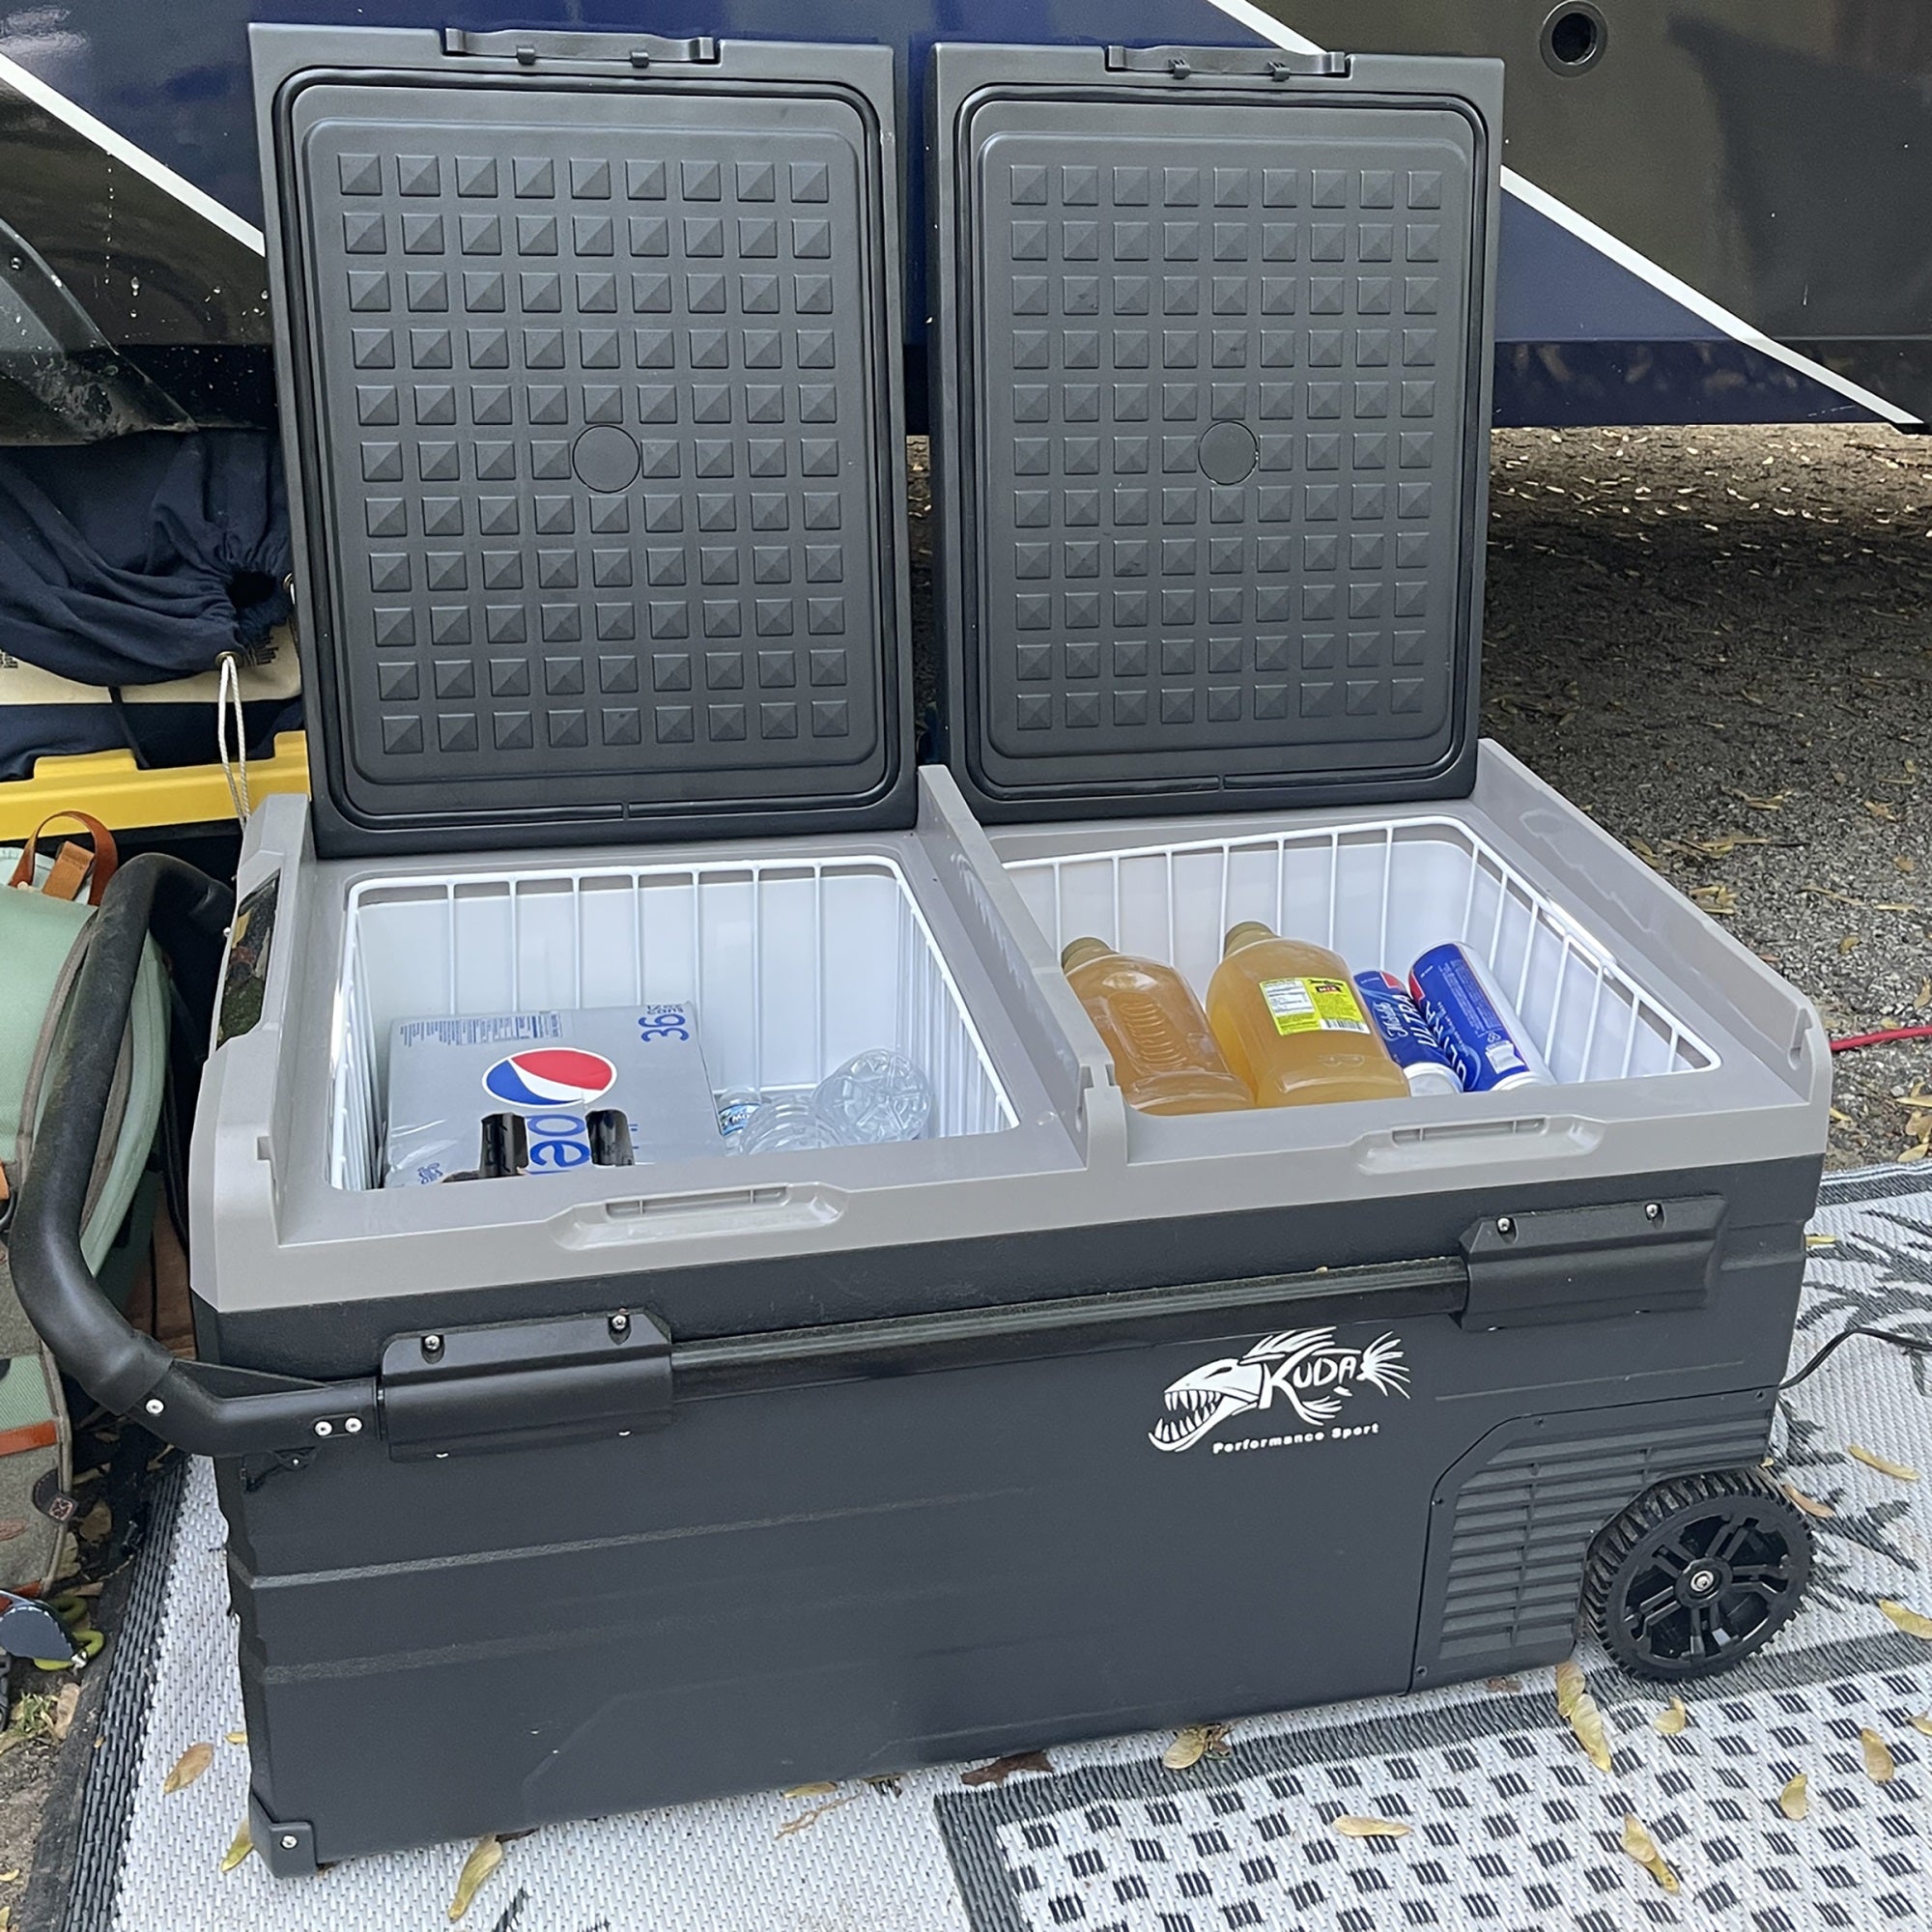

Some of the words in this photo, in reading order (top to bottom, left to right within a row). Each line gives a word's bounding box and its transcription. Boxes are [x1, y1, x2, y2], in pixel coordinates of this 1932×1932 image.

[638, 1013, 690, 1042] 36
[1391, 994, 1438, 1048] ULTRA
[1259, 1341, 1357, 1412] KUDA
[1212, 1432, 1324, 1455] Performance
[1331, 1423, 1379, 1439] Sport
